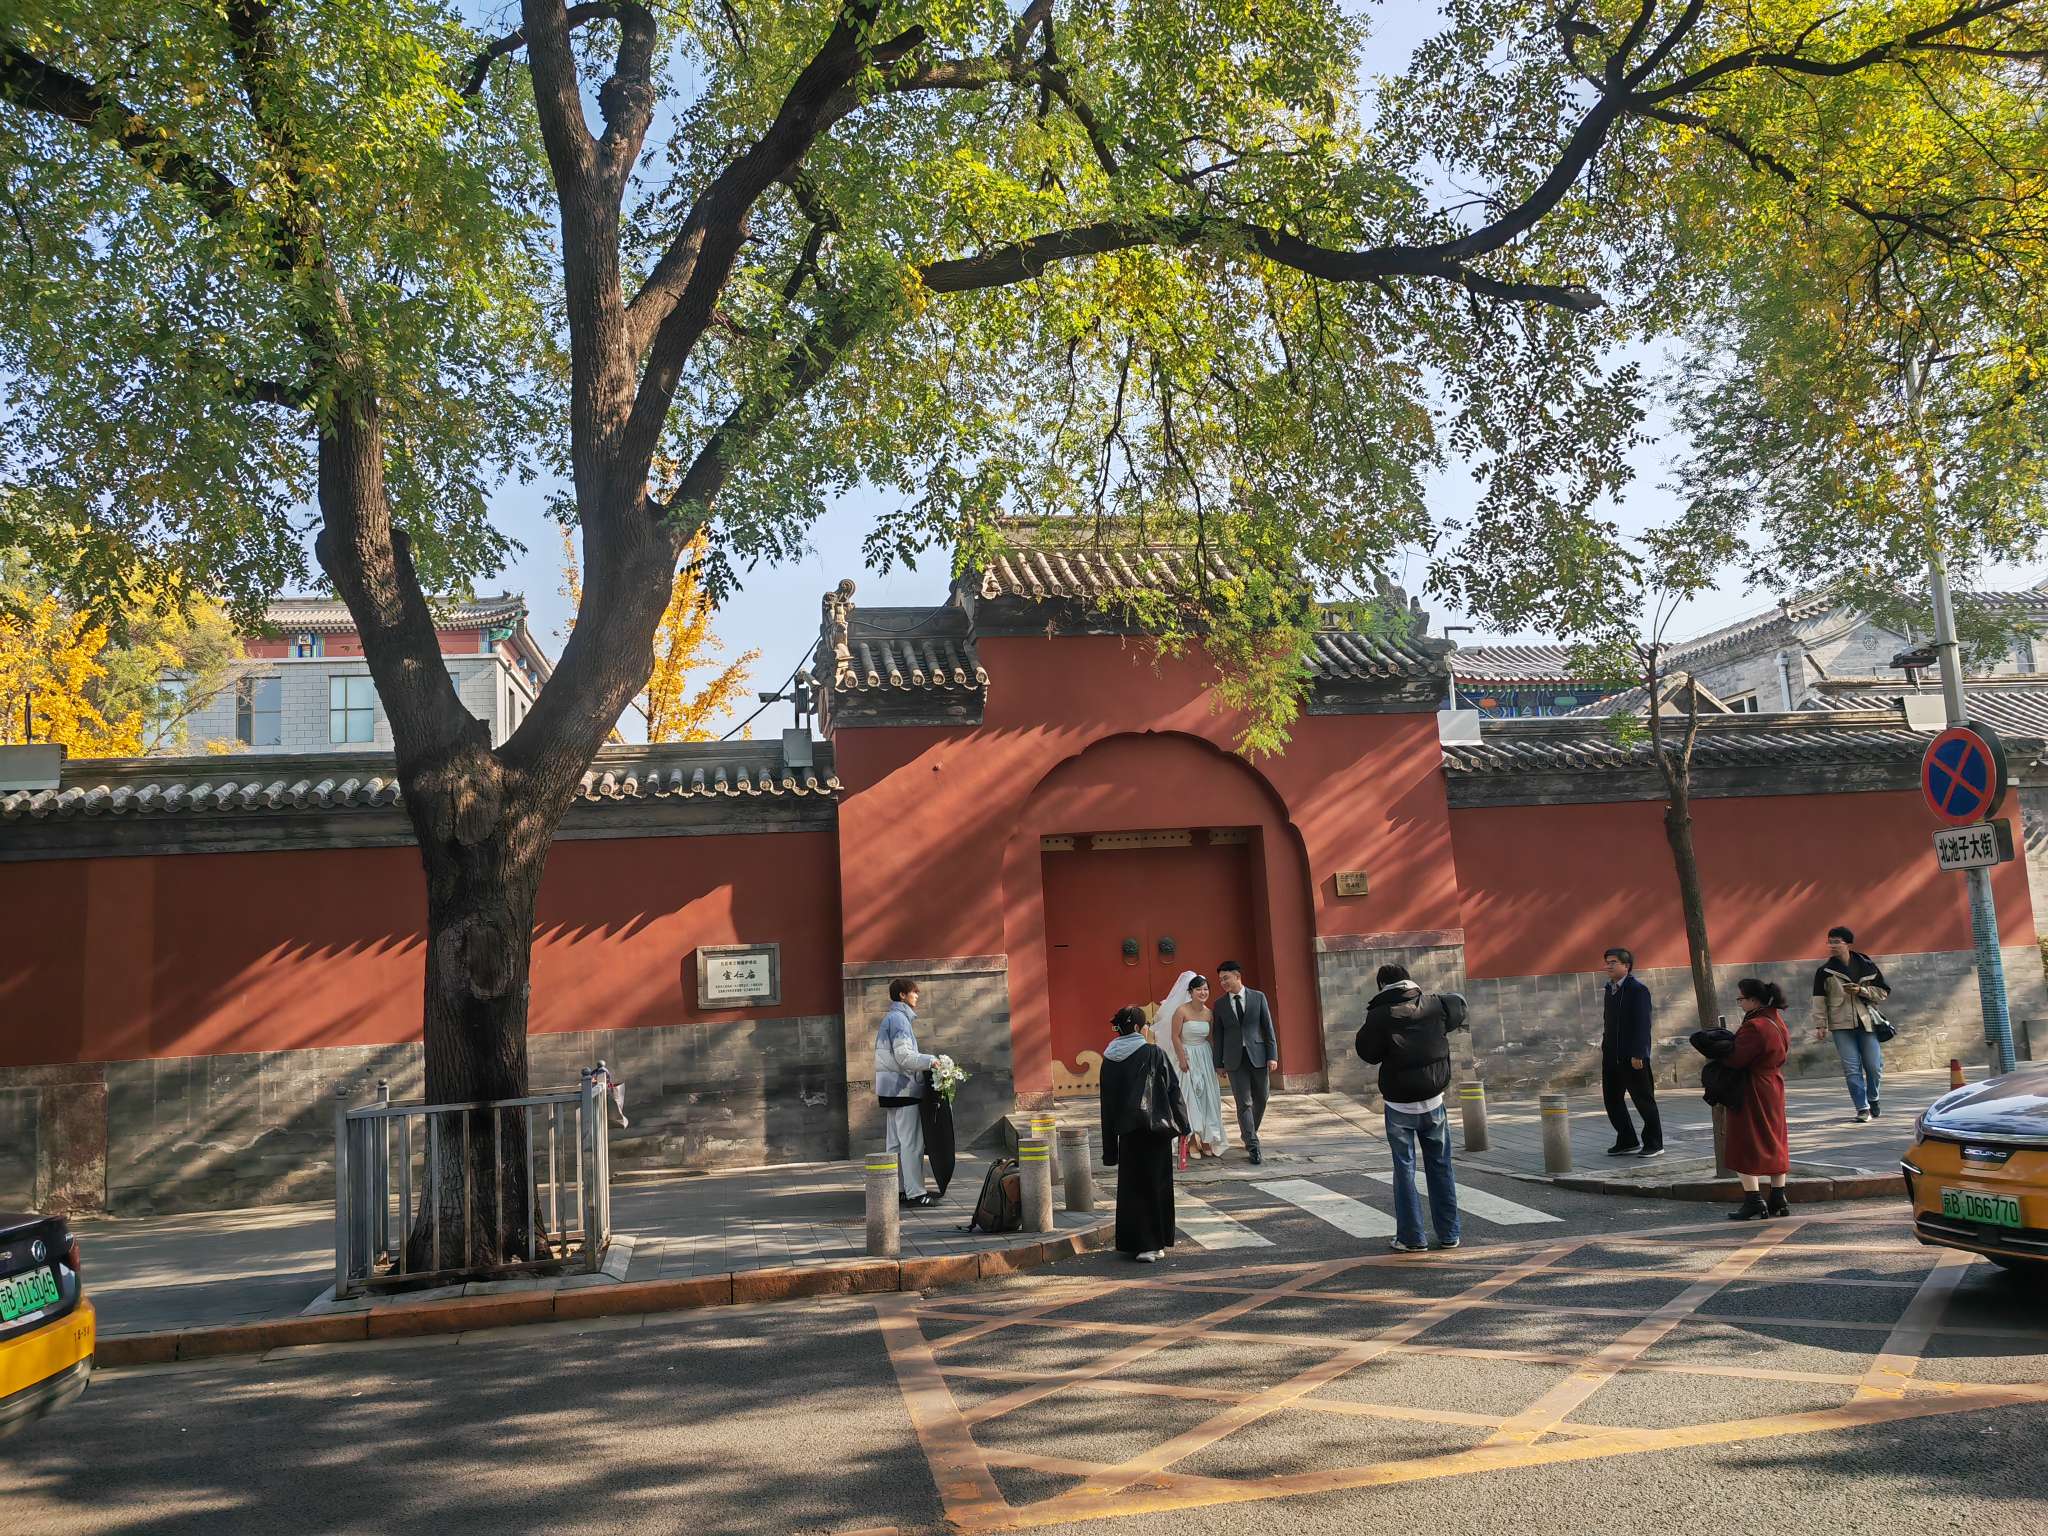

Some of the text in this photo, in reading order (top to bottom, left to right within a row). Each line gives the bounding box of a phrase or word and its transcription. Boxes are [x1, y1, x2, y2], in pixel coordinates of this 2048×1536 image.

[1939, 833, 1993, 864] 北池子大街
